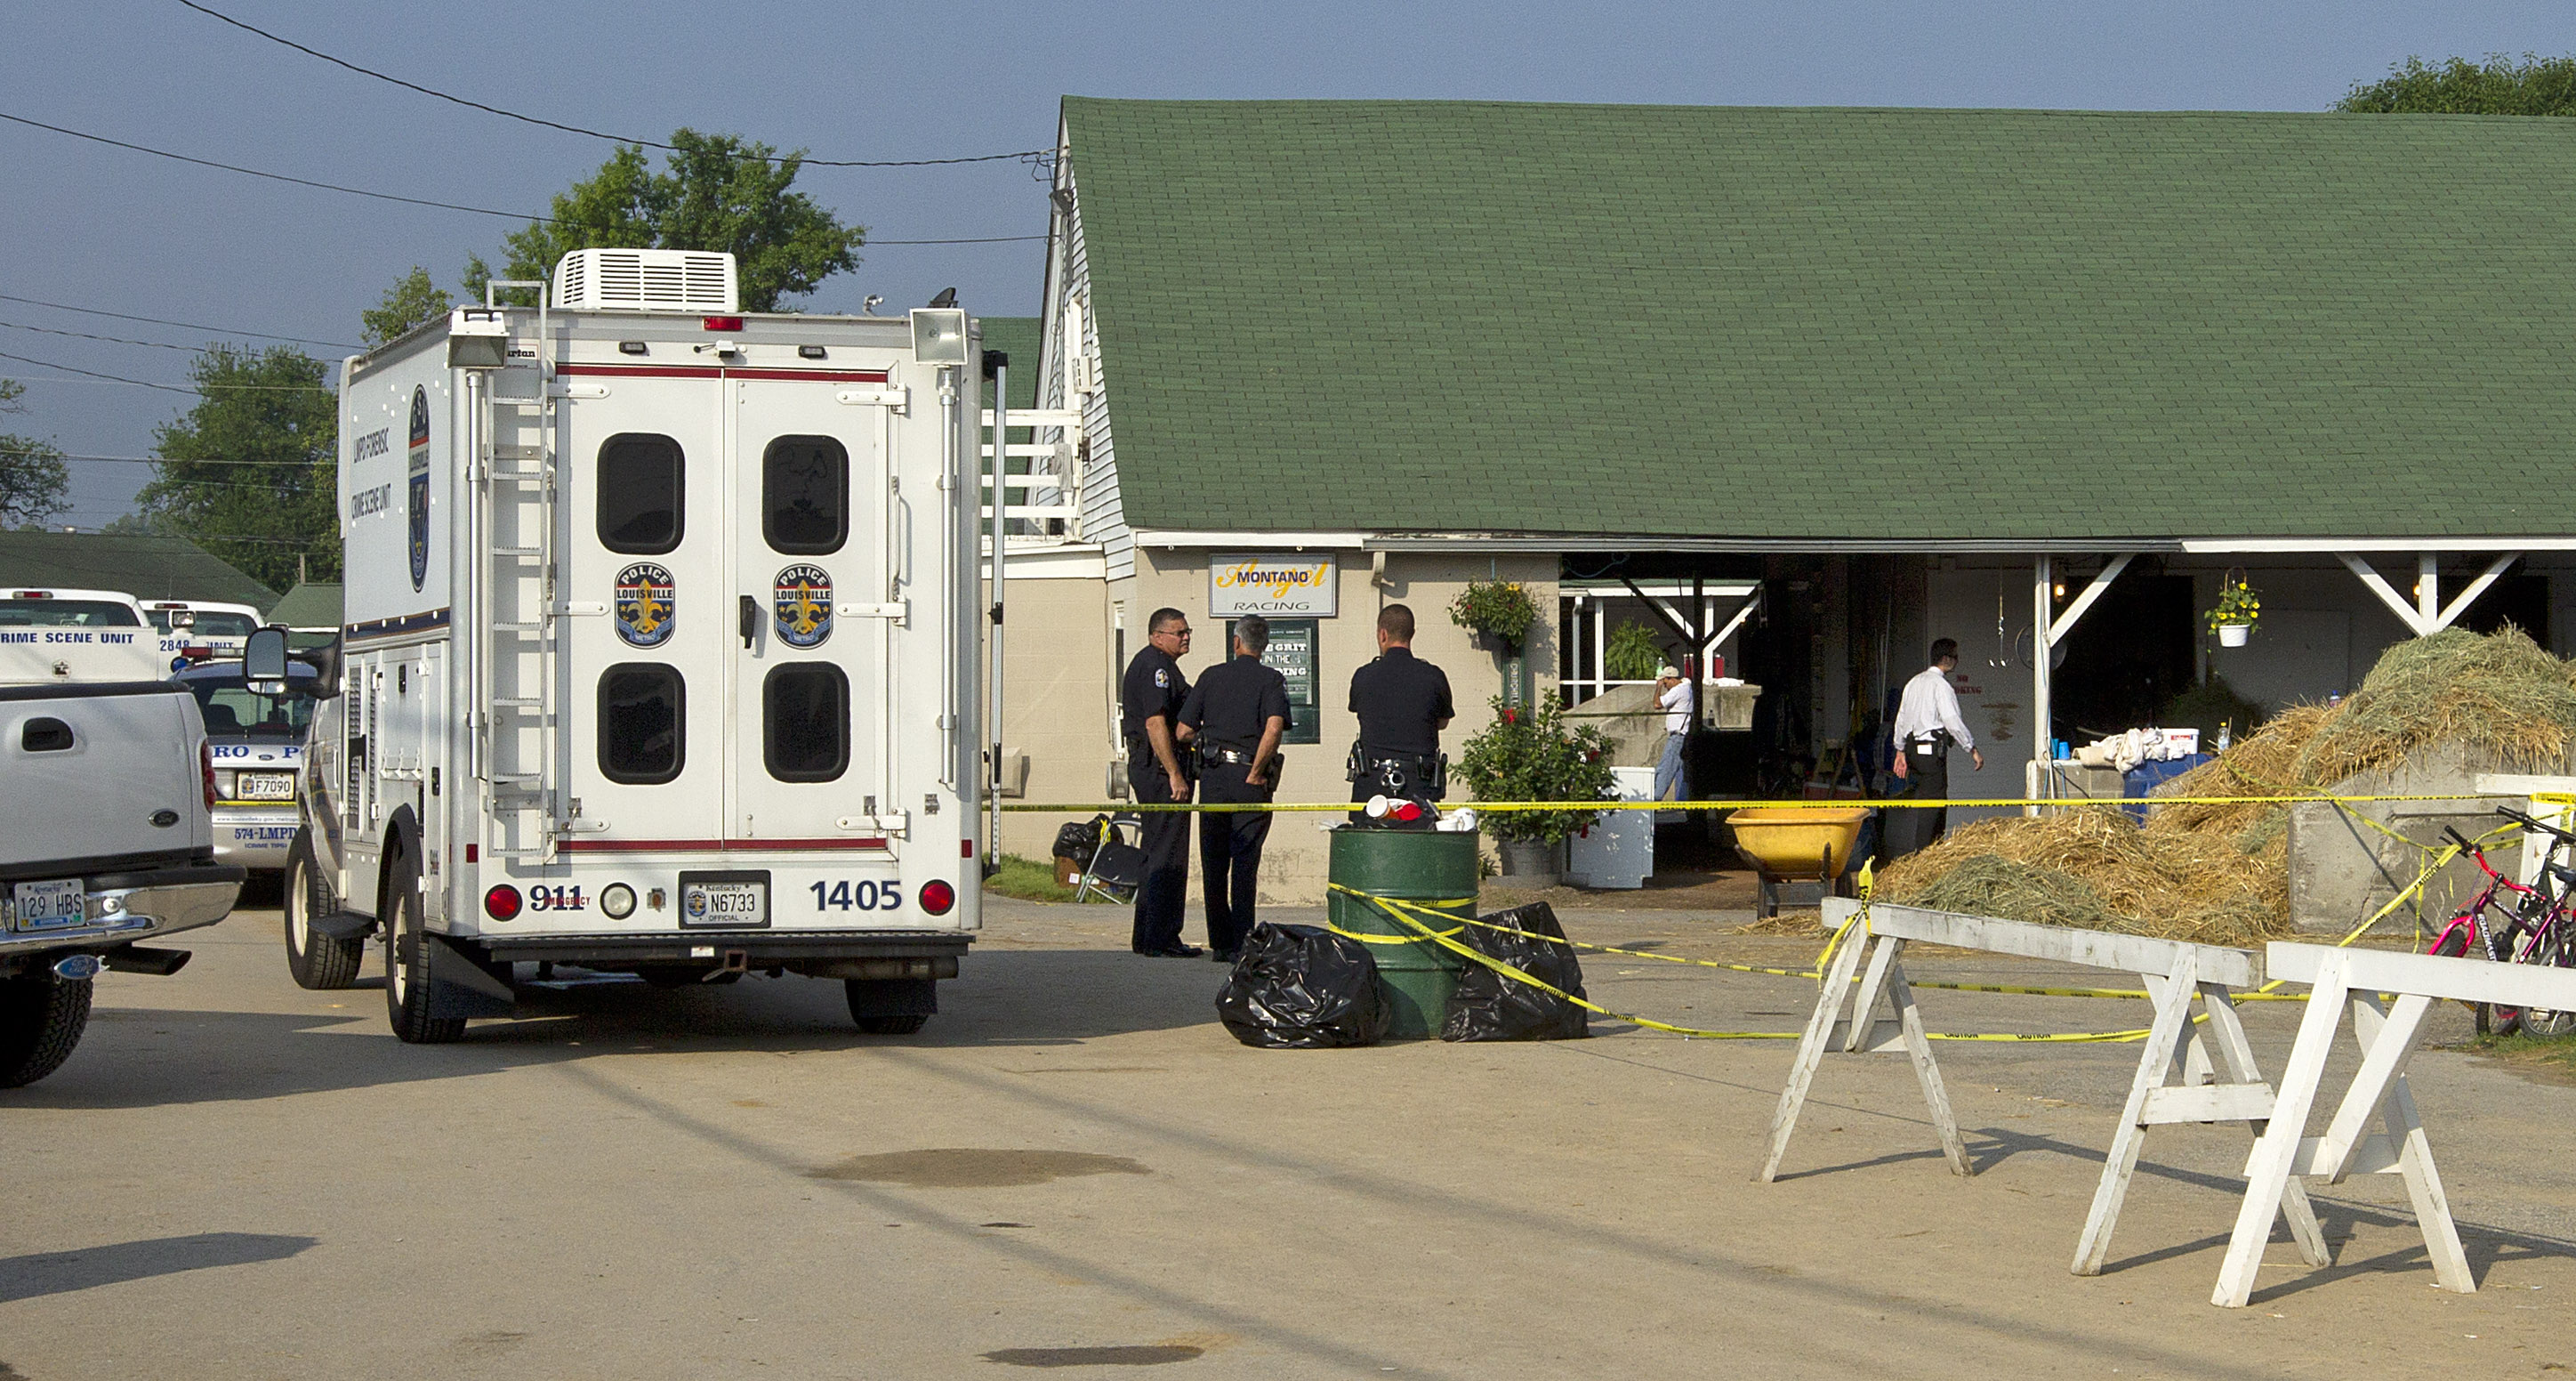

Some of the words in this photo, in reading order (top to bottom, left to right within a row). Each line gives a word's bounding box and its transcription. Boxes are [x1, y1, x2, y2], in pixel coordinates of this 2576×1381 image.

[621, 566, 669, 585] POLICE
[780, 568, 827, 586] POLICE
[1237, 571, 1308, 583] MONTANO
[617, 589, 672, 599] LOUISVILLE
[776, 590, 830, 600] LOUISVILLE
[1234, 602, 1309, 611] RACING
[0, 633, 37, 643] RIME
[45, 633, 93, 643] SCENE
[101, 634, 134, 643] UNIT
[159, 640, 190, 651] 2848
[1275, 643, 1307, 651] GRIT
[1265, 655, 1273, 664] IN
[1276, 655, 1290, 664] THE
[255, 780, 290, 792] F7090
[529, 884, 584, 912] 911
[810, 880, 902, 911] 1405
[20, 895, 46, 918] 129
[55, 892, 83, 916] HBS
[711, 893, 755, 912] N6733
[2477, 913, 2498, 962] ROADMAST
